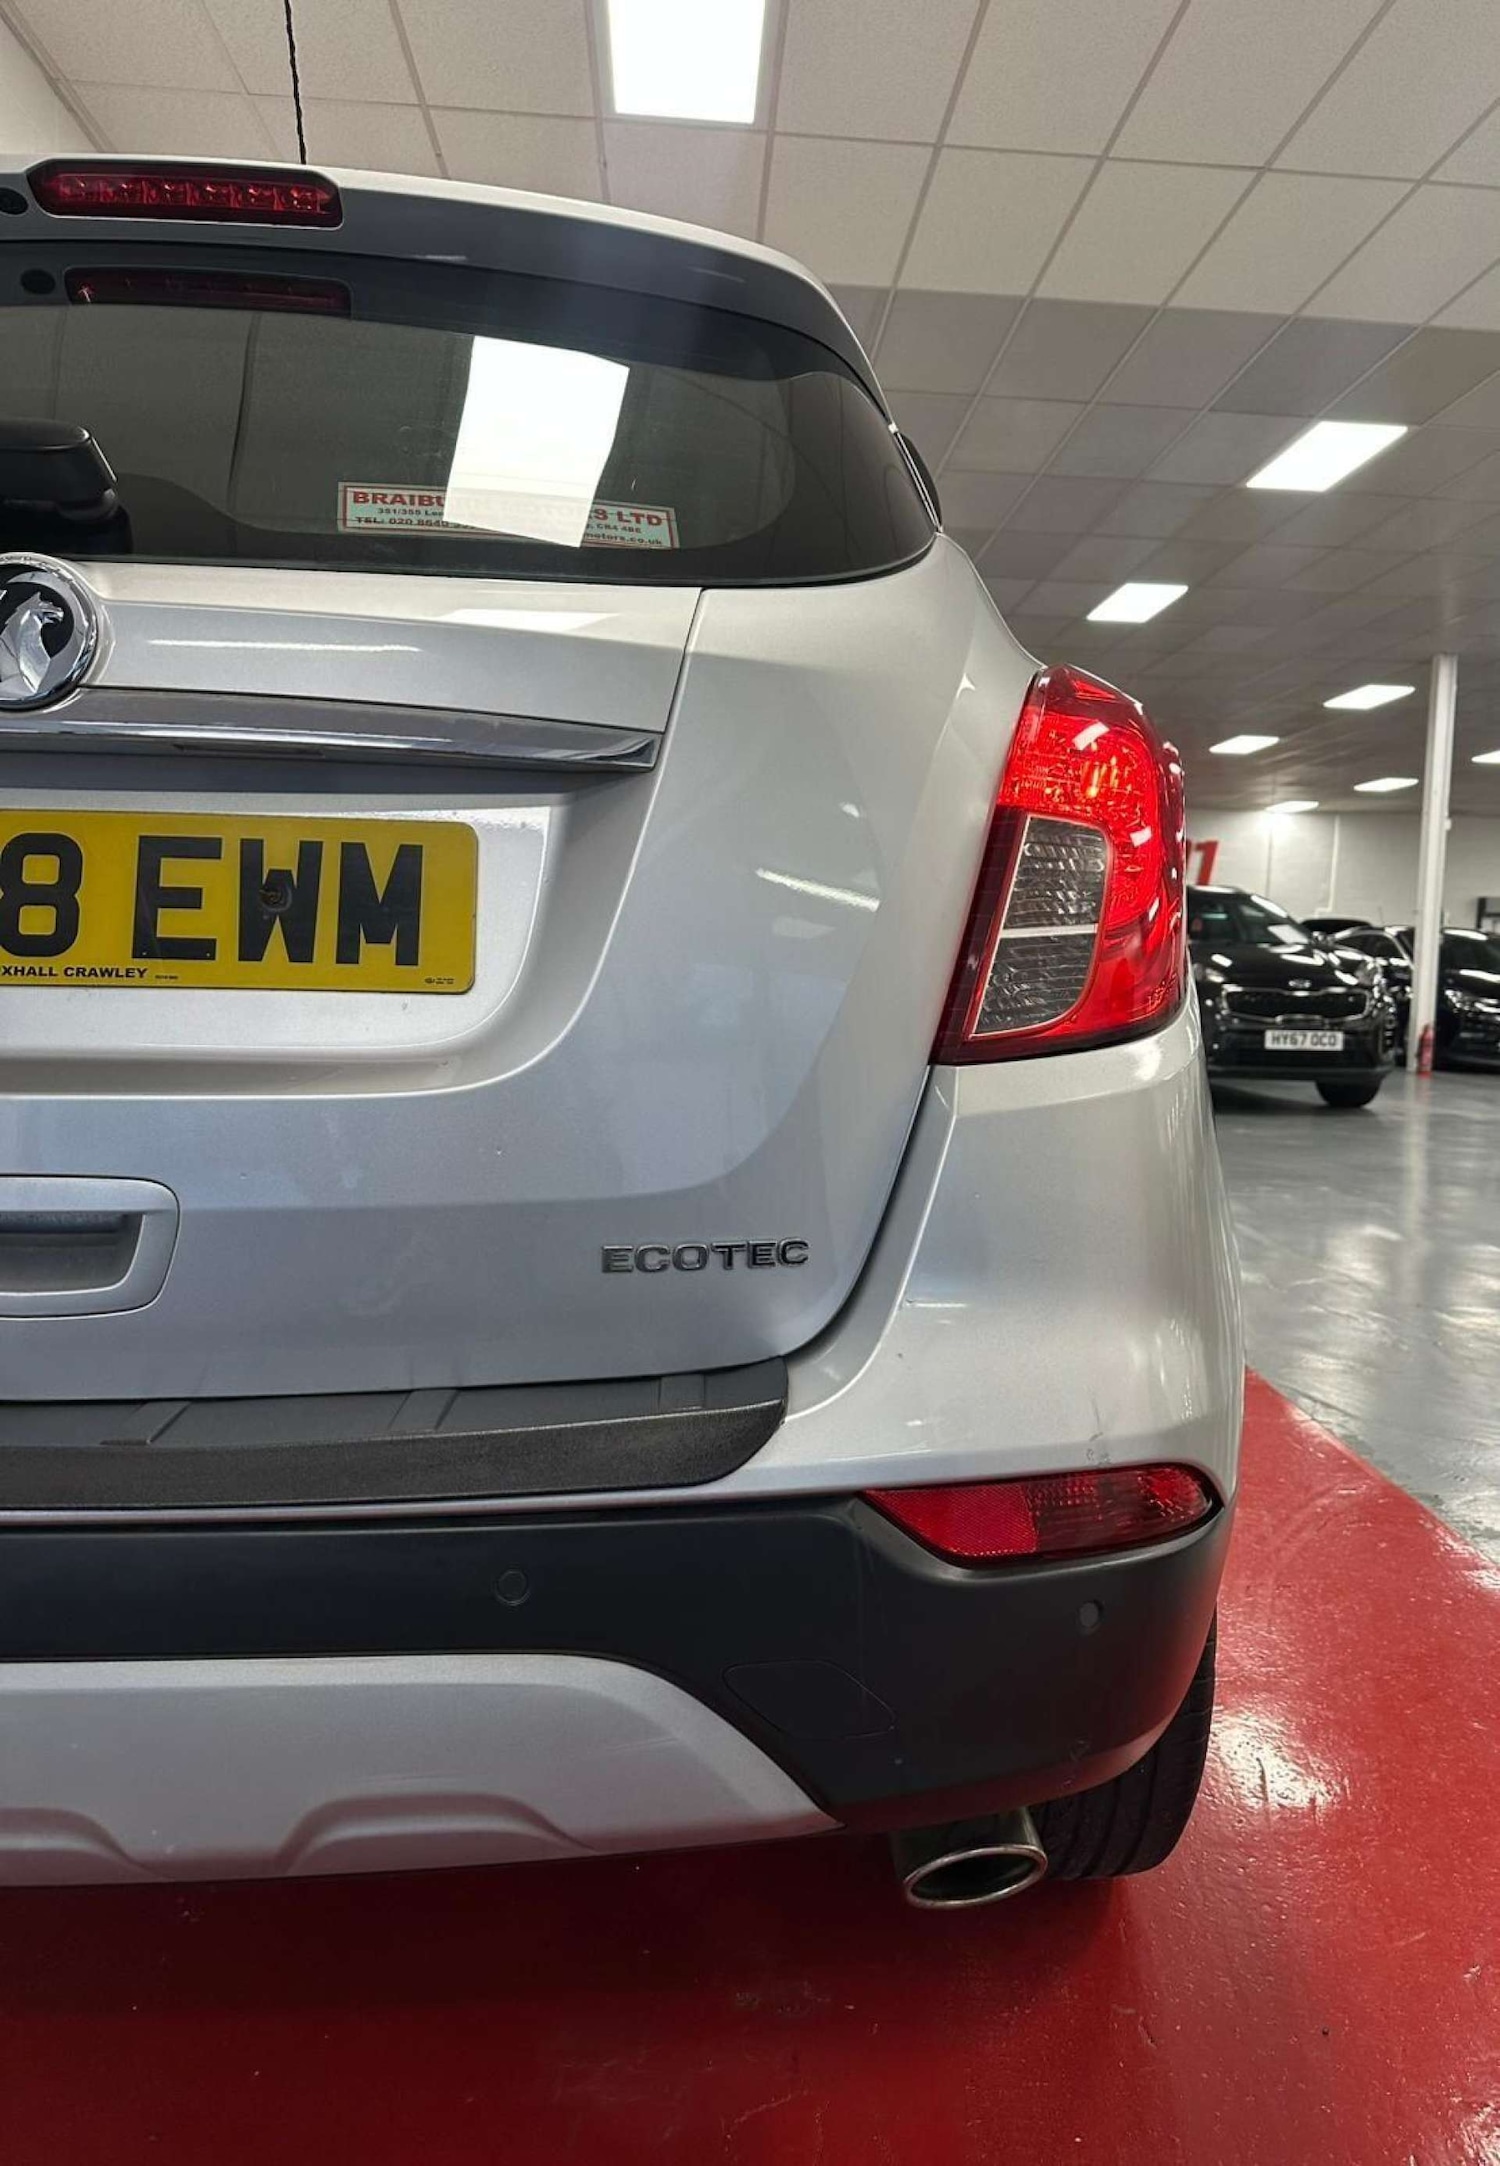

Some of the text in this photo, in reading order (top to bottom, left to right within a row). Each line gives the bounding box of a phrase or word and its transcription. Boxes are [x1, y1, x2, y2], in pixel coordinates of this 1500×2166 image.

[389, 518, 411, 526] 020
[617, 511, 662, 526] LTD
[132, 835, 424, 966] EWM
[1, 965, 57, 977] XHALL
[64, 966, 148, 978] CRAWLEY
[1271, 1033, 1307, 1046] HY67
[601, 1237, 810, 1274] ECOTEC
